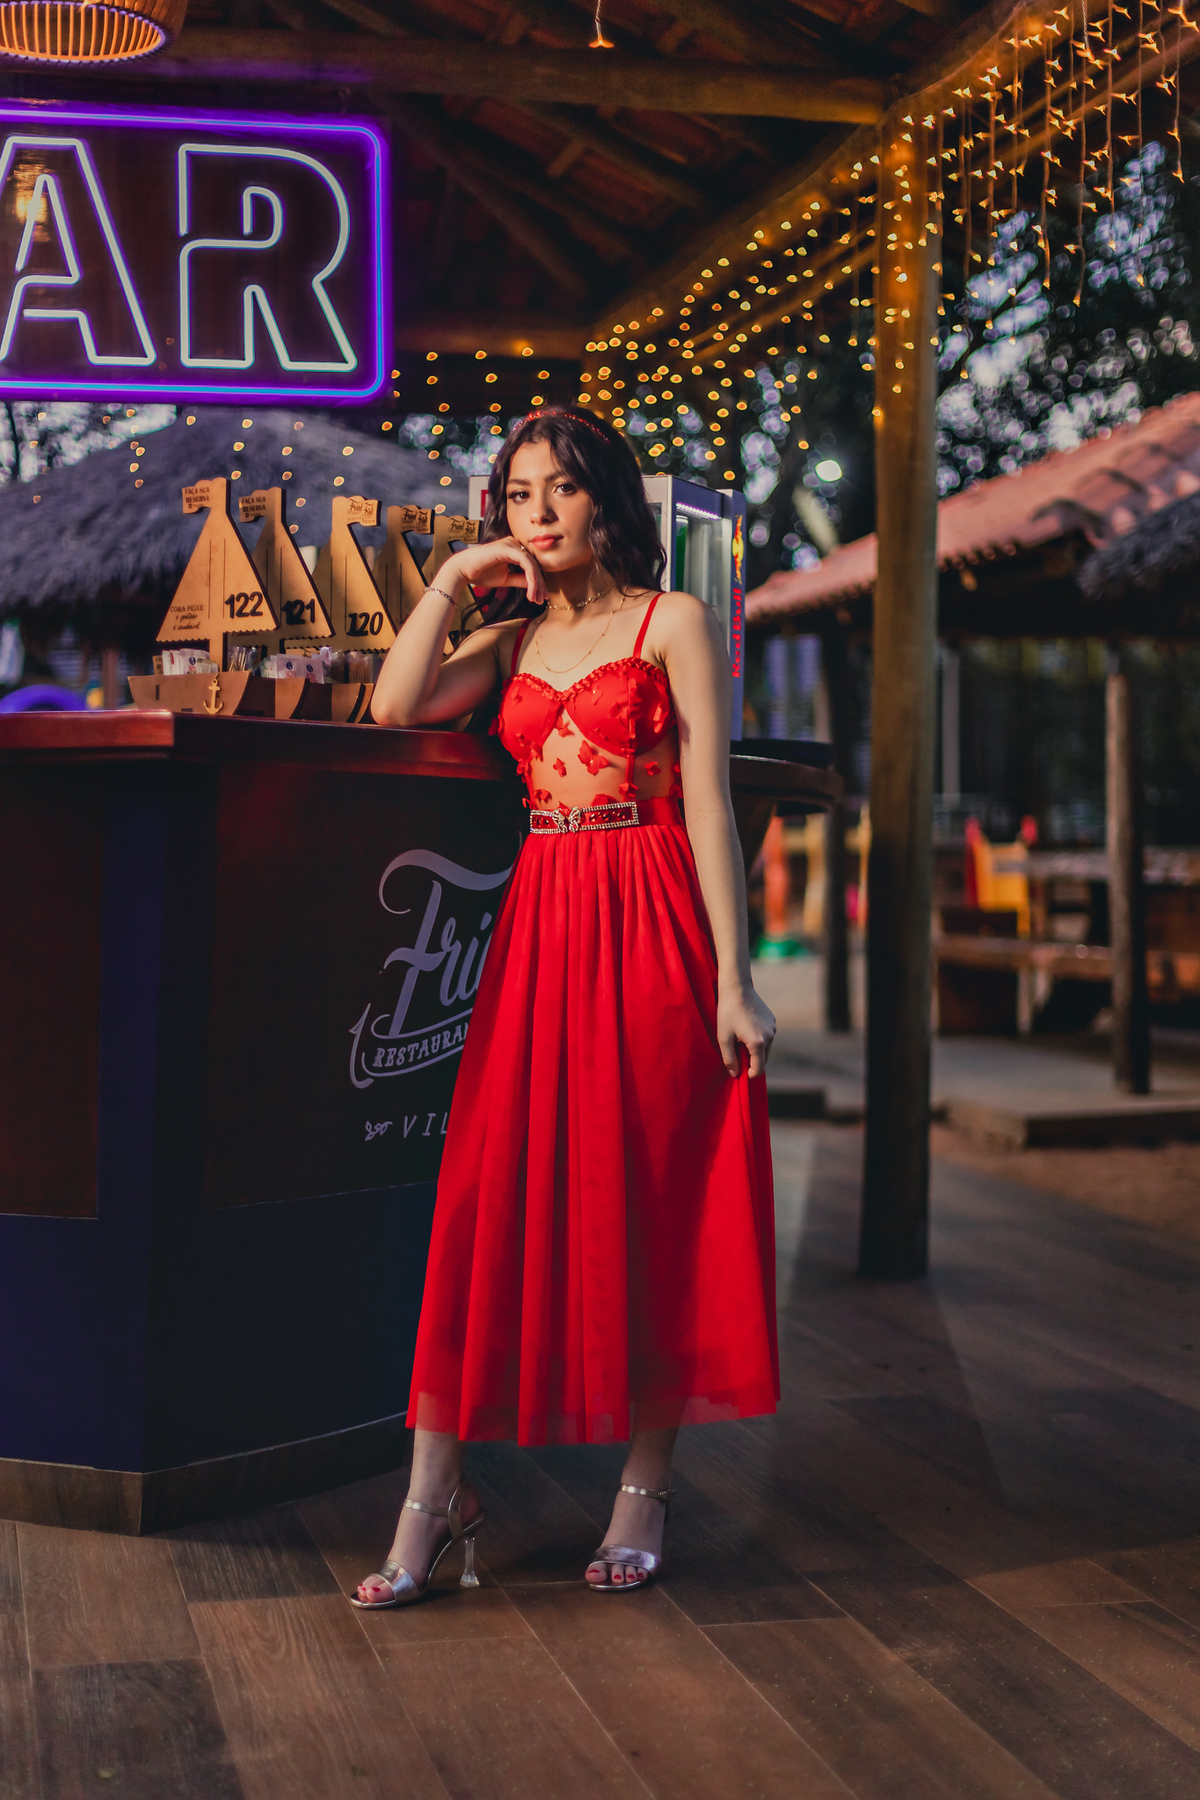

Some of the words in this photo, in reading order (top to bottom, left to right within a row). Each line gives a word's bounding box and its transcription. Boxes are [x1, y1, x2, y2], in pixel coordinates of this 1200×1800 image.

[185, 487, 198, 495] FAÇA
[185, 495, 210, 503] RESERVA
[241, 497, 255, 505] FAÇA
[242, 504, 266, 512] RESERVA
[170, 605, 186, 613] COMA
[187, 604, 204, 612] PEIXE
[224, 591, 263, 619] 122
[281, 598, 315, 625] 121
[733, 588, 742, 631] Bull
[346, 611, 384, 636] 120
[732, 634, 741, 678] Red
